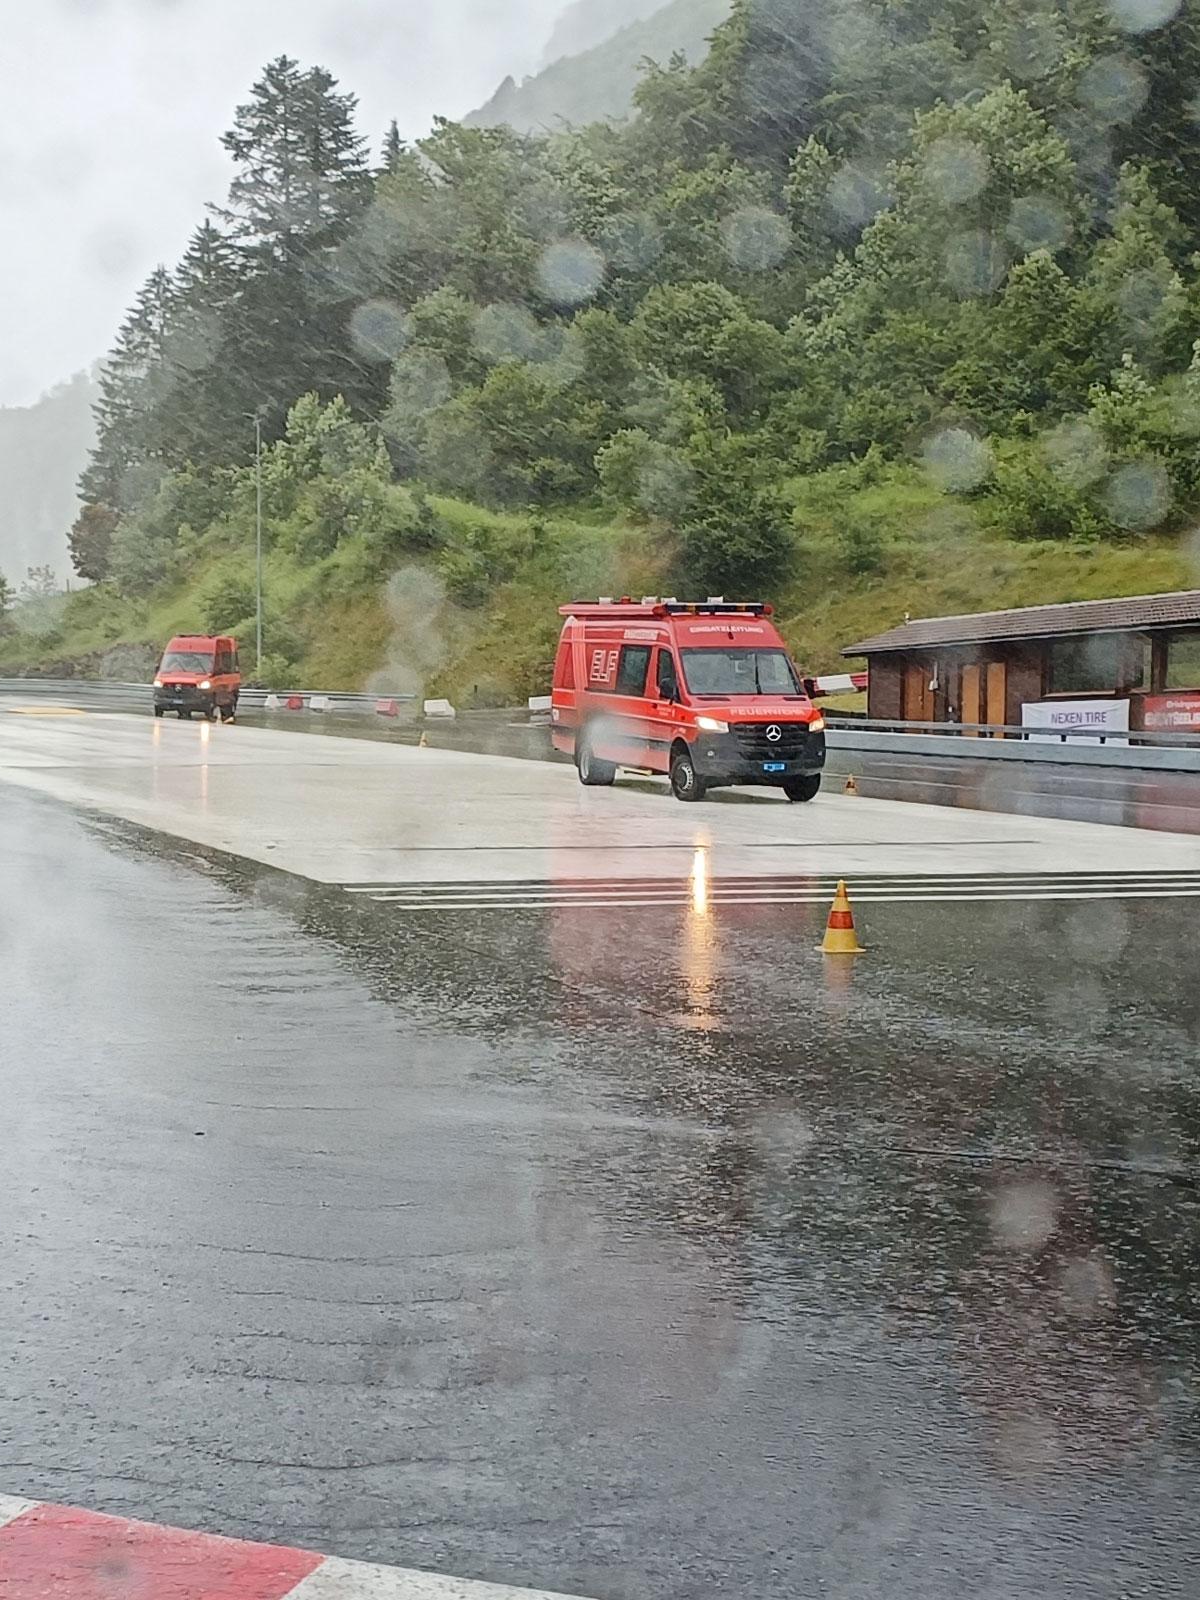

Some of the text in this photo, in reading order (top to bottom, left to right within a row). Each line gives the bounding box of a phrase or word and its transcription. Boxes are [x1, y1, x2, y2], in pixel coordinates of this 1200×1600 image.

[730, 707, 804, 715] FEUERWEHR
[1051, 712, 1107, 723] NEXEN TIRE
